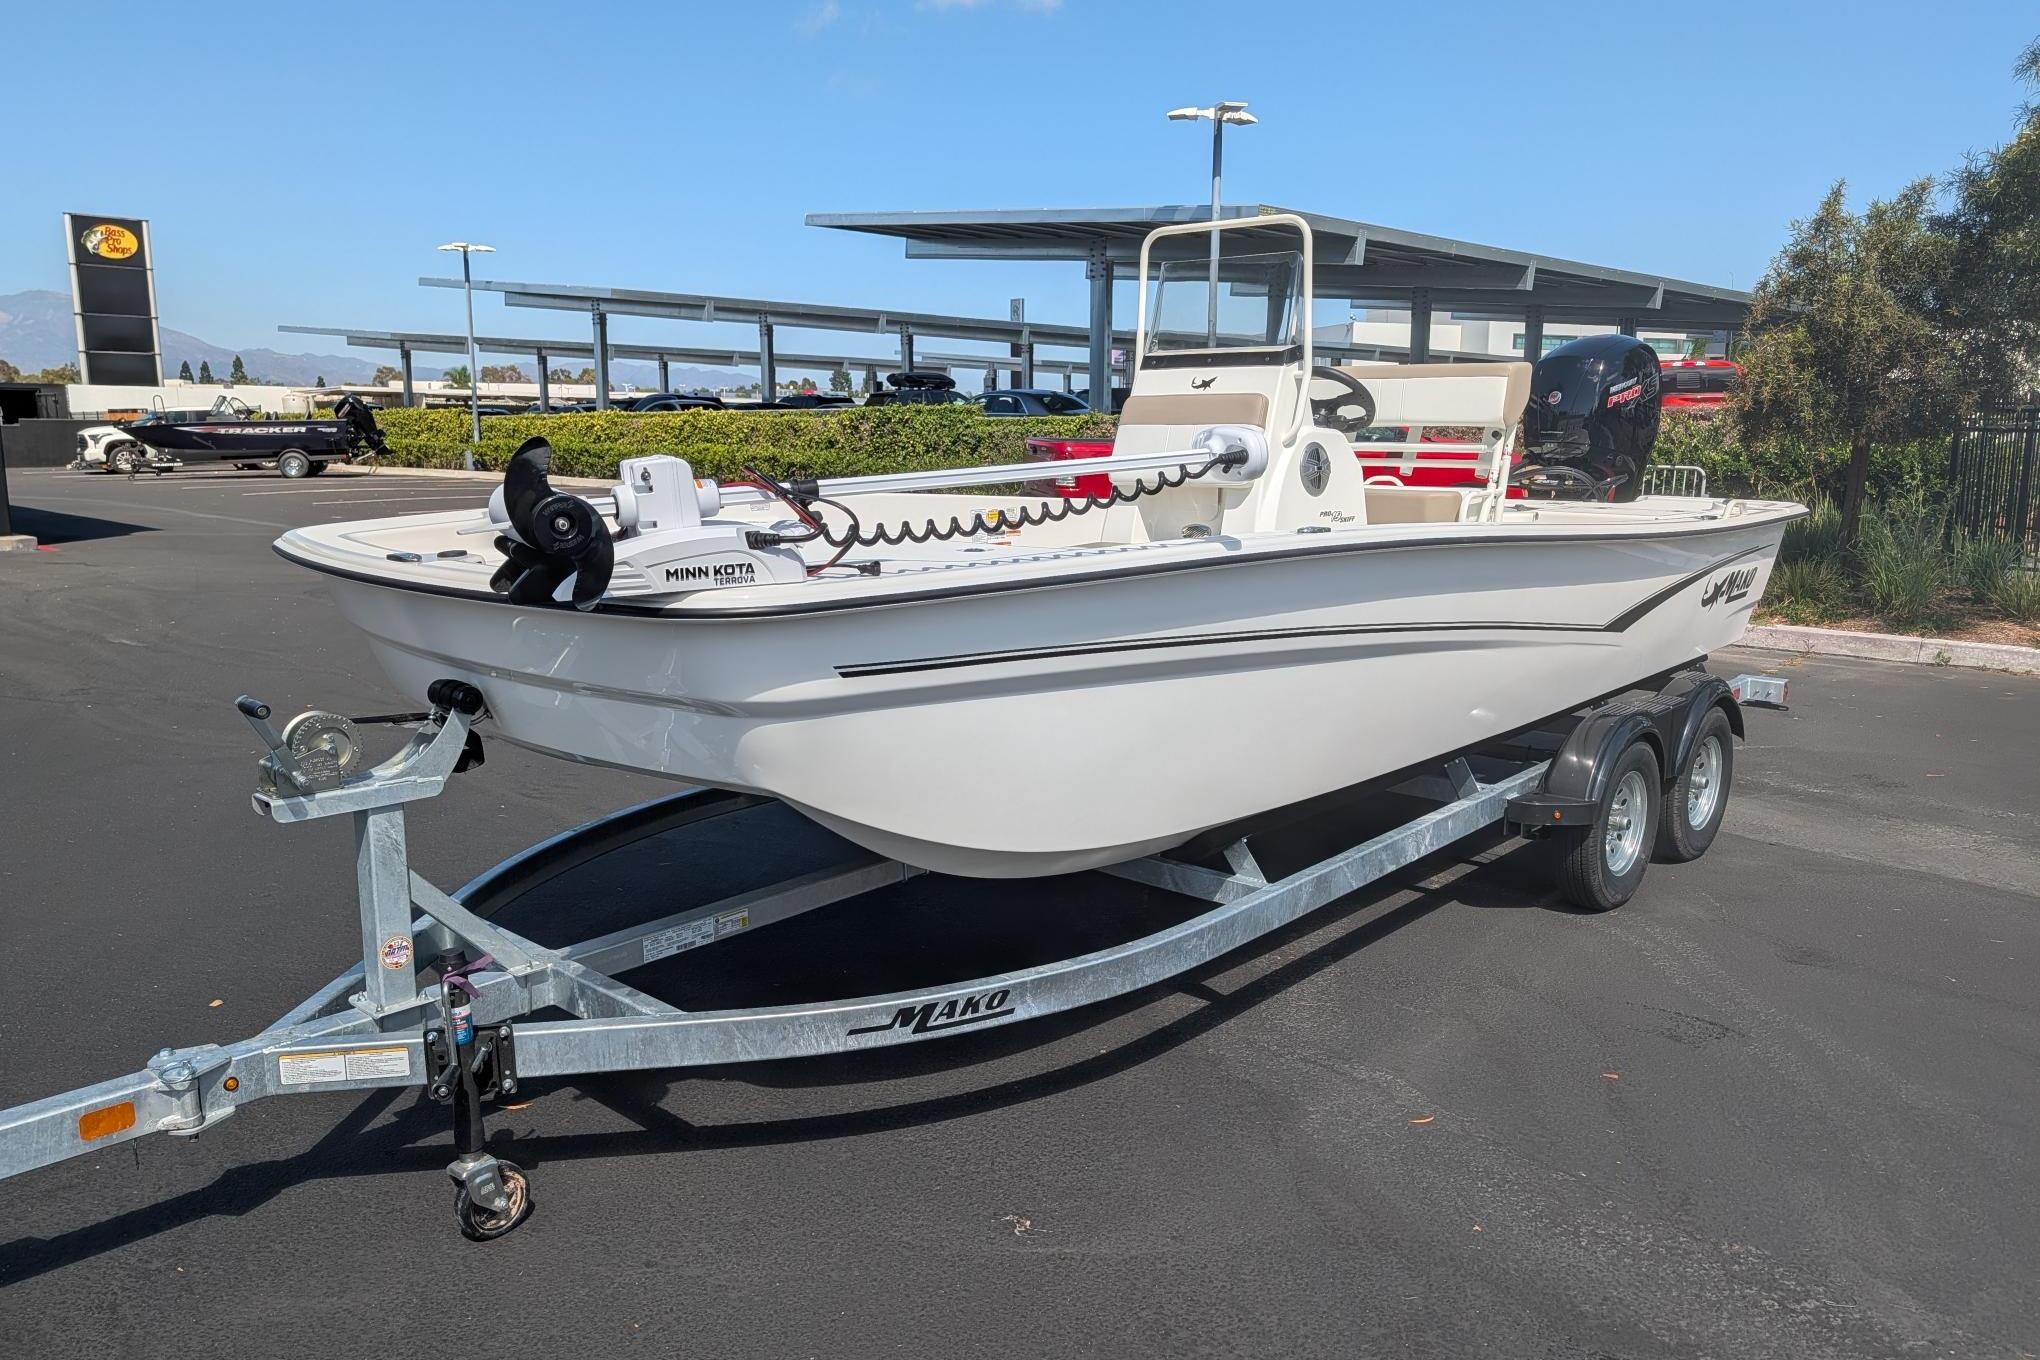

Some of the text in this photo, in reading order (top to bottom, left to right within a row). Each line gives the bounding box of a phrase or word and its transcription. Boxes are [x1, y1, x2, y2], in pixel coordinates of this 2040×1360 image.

[105, 226, 125, 238] Bass
[106, 235, 121, 245] Pro
[107, 244, 132, 256] Shops
[1607, 384, 1641, 408] PRO
[217, 426, 307, 434] TRACKER
[665, 562, 756, 582] MINN KOTA
[713, 575, 756, 587] TERROVA
[1719, 566, 1758, 604] MAKO
[847, 989, 1016, 1036] MAKO
